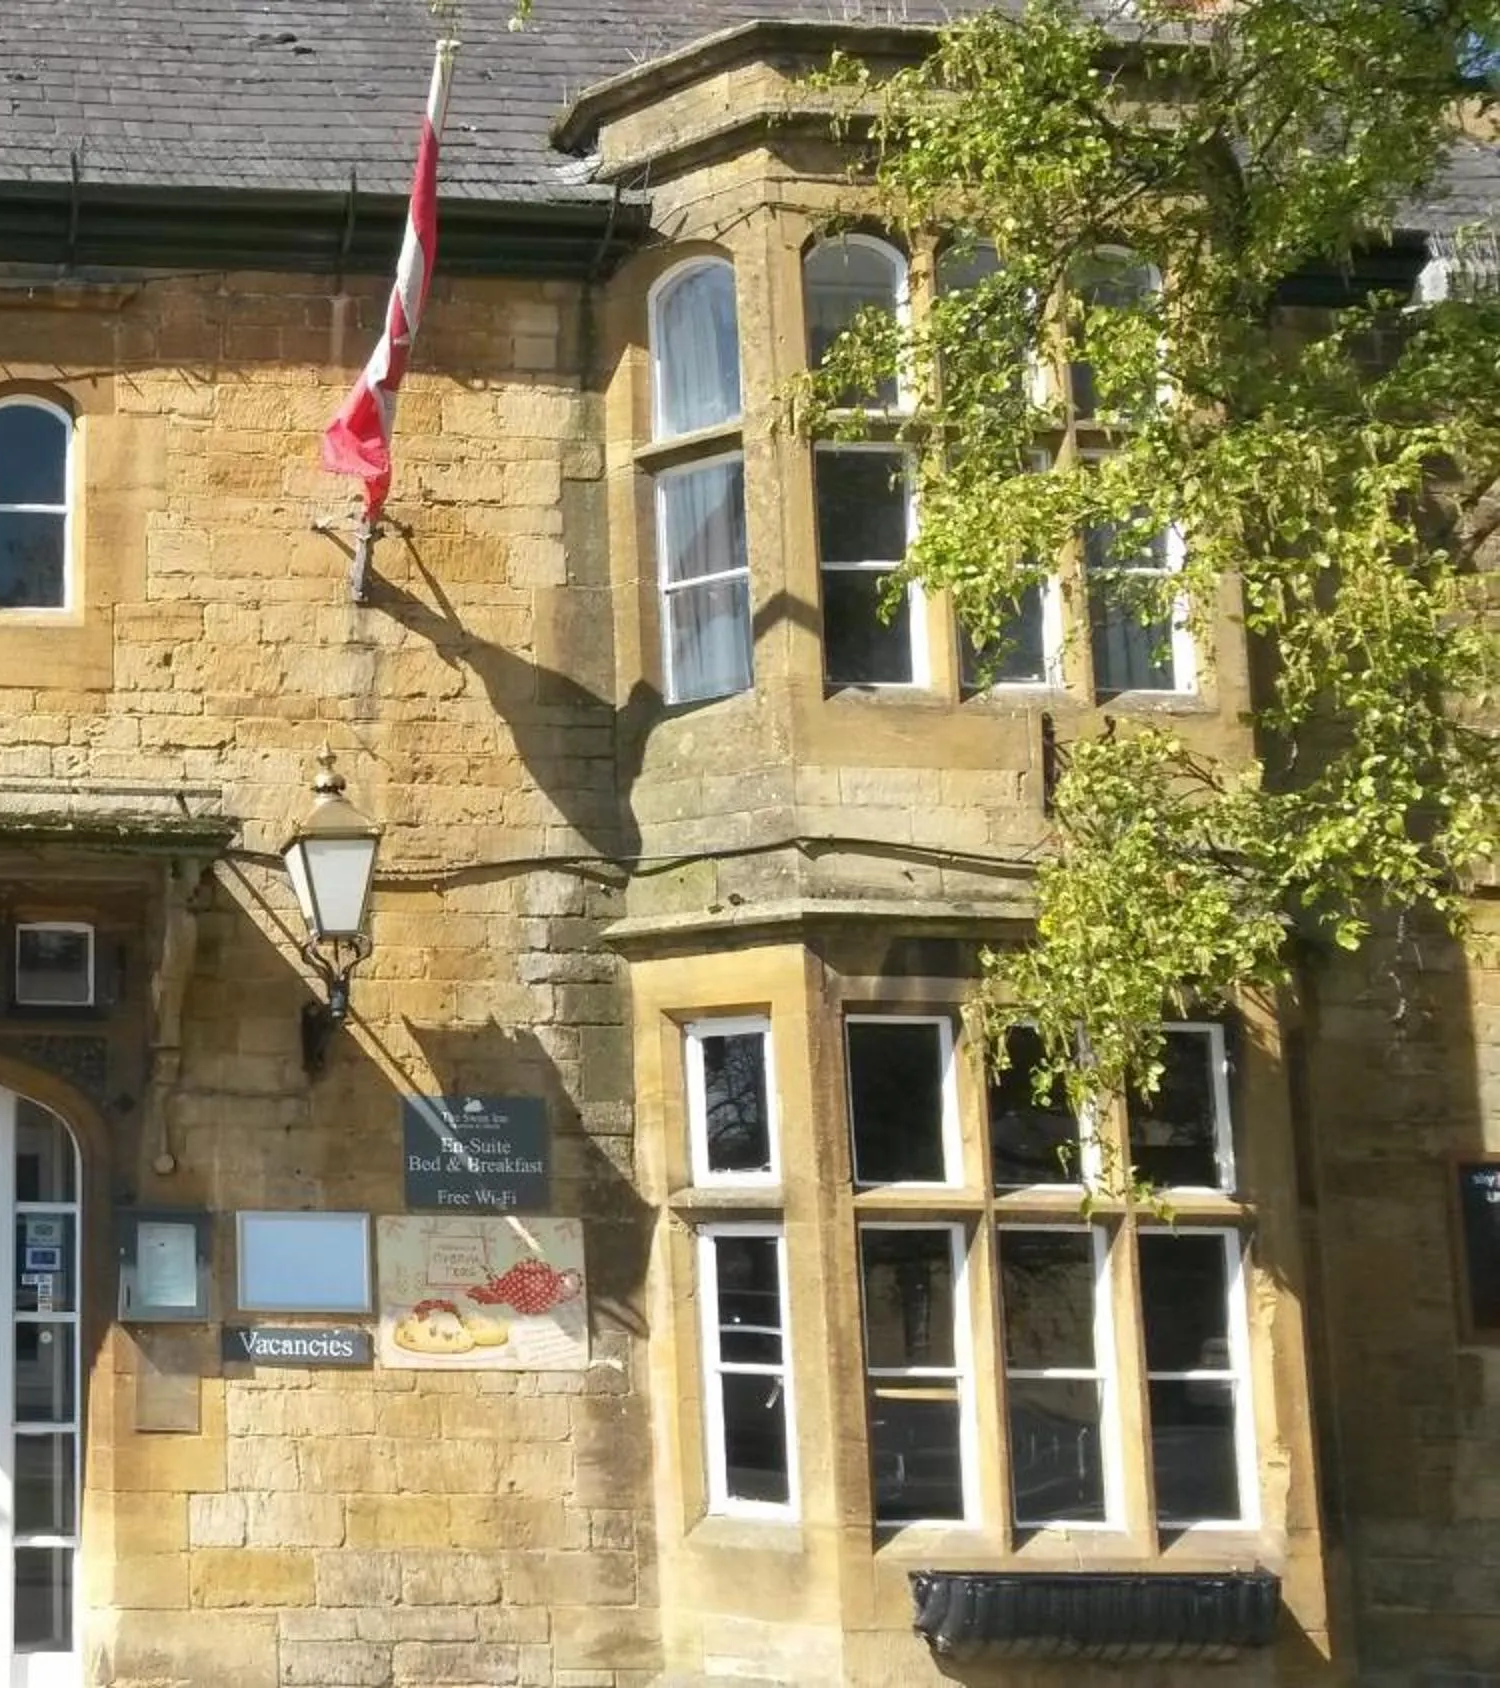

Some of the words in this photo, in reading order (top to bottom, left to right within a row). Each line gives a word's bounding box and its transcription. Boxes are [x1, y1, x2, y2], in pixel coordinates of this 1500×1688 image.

[440, 1137, 511, 1153] En-Suite
[409, 1155, 441, 1171] Bed
[446, 1158, 462, 1172] &
[467, 1157, 543, 1173] Breakfast
[437, 1189, 471, 1205] Free
[475, 1189, 517, 1206] Wi-Fi
[239, 1330, 354, 1357] Vacancies
